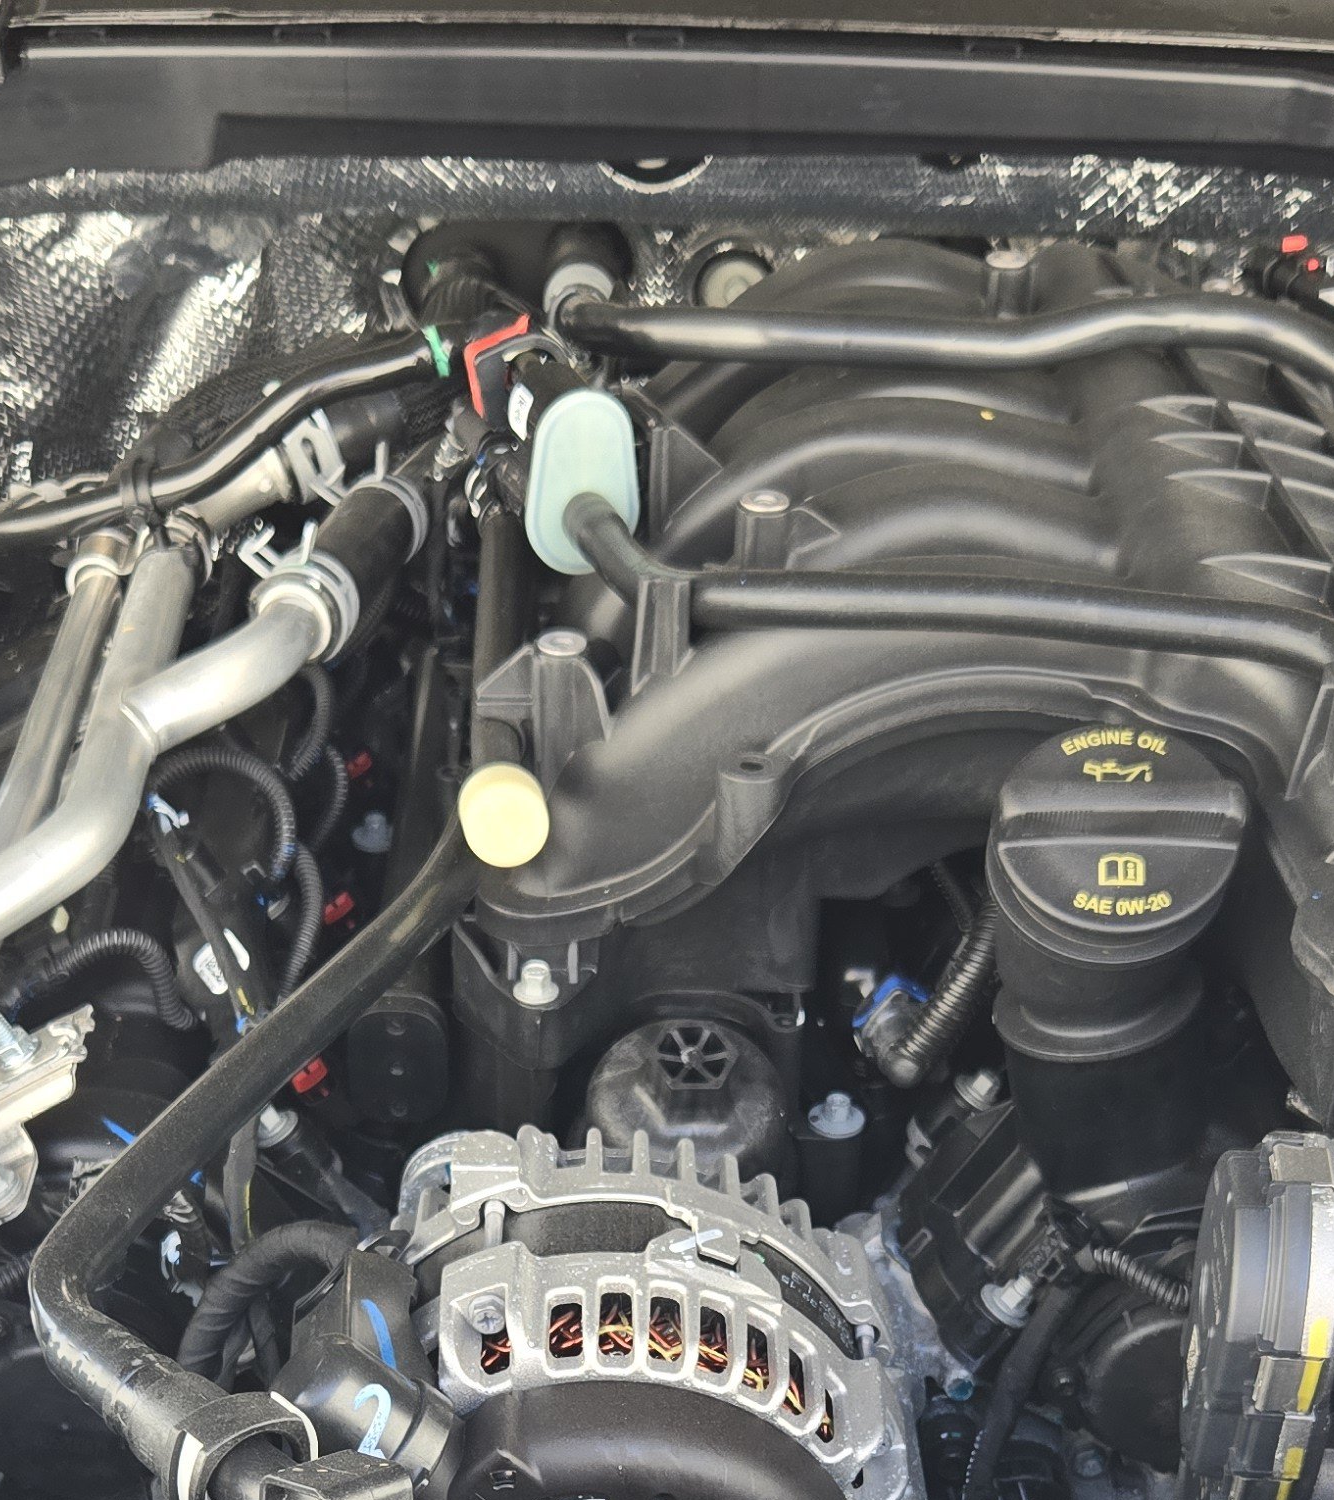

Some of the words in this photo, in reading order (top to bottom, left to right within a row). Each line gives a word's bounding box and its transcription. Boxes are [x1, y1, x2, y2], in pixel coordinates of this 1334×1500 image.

[1061, 730, 1134, 756] ENGINE
[1137, 735, 1169, 756] OIL
[1073, 891, 1113, 915] SAE
[1116, 891, 1172, 916] 0W-20
